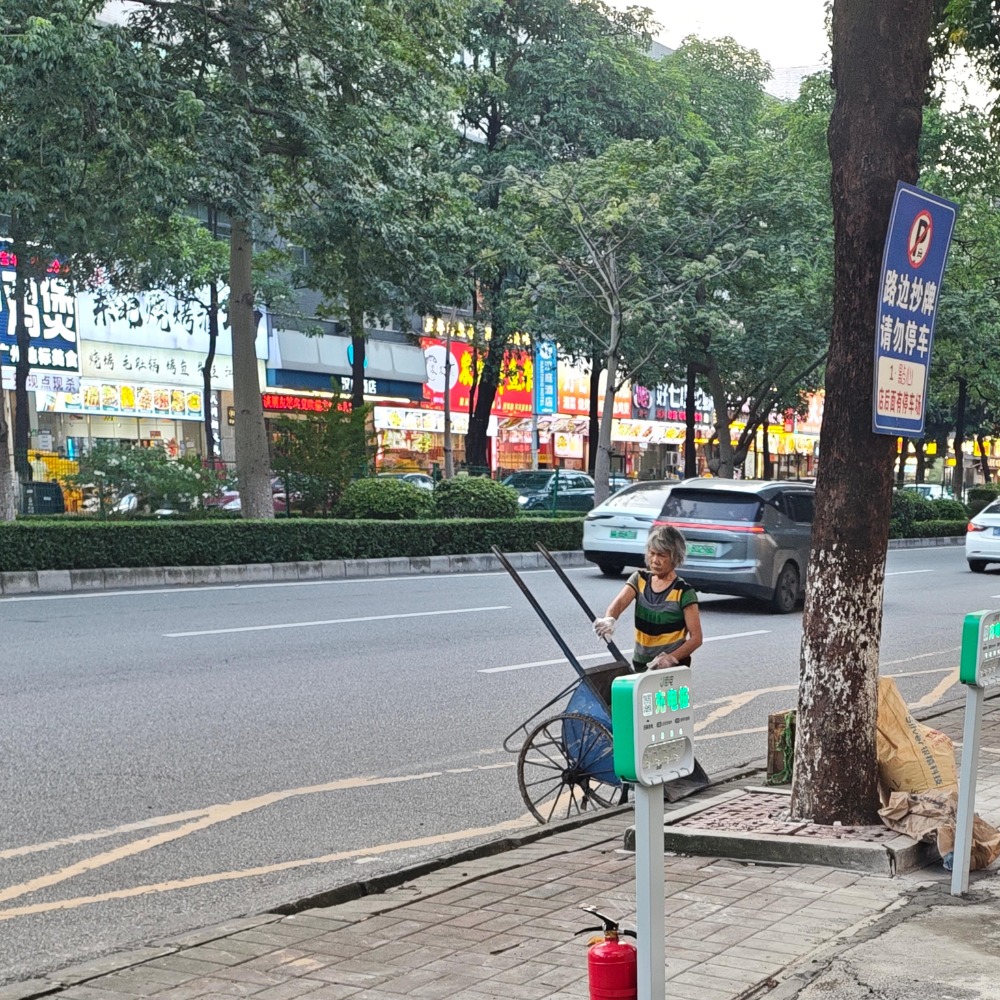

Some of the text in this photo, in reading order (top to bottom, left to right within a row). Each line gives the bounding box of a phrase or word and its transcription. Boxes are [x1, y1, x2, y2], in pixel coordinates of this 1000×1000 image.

[882, 269, 938, 317] 路边抄牌
[880, 314, 931, 359] 请勿停车
[878, 389, 922, 417] 店后面有停车场
[905, 715, 923, 747] Silver
